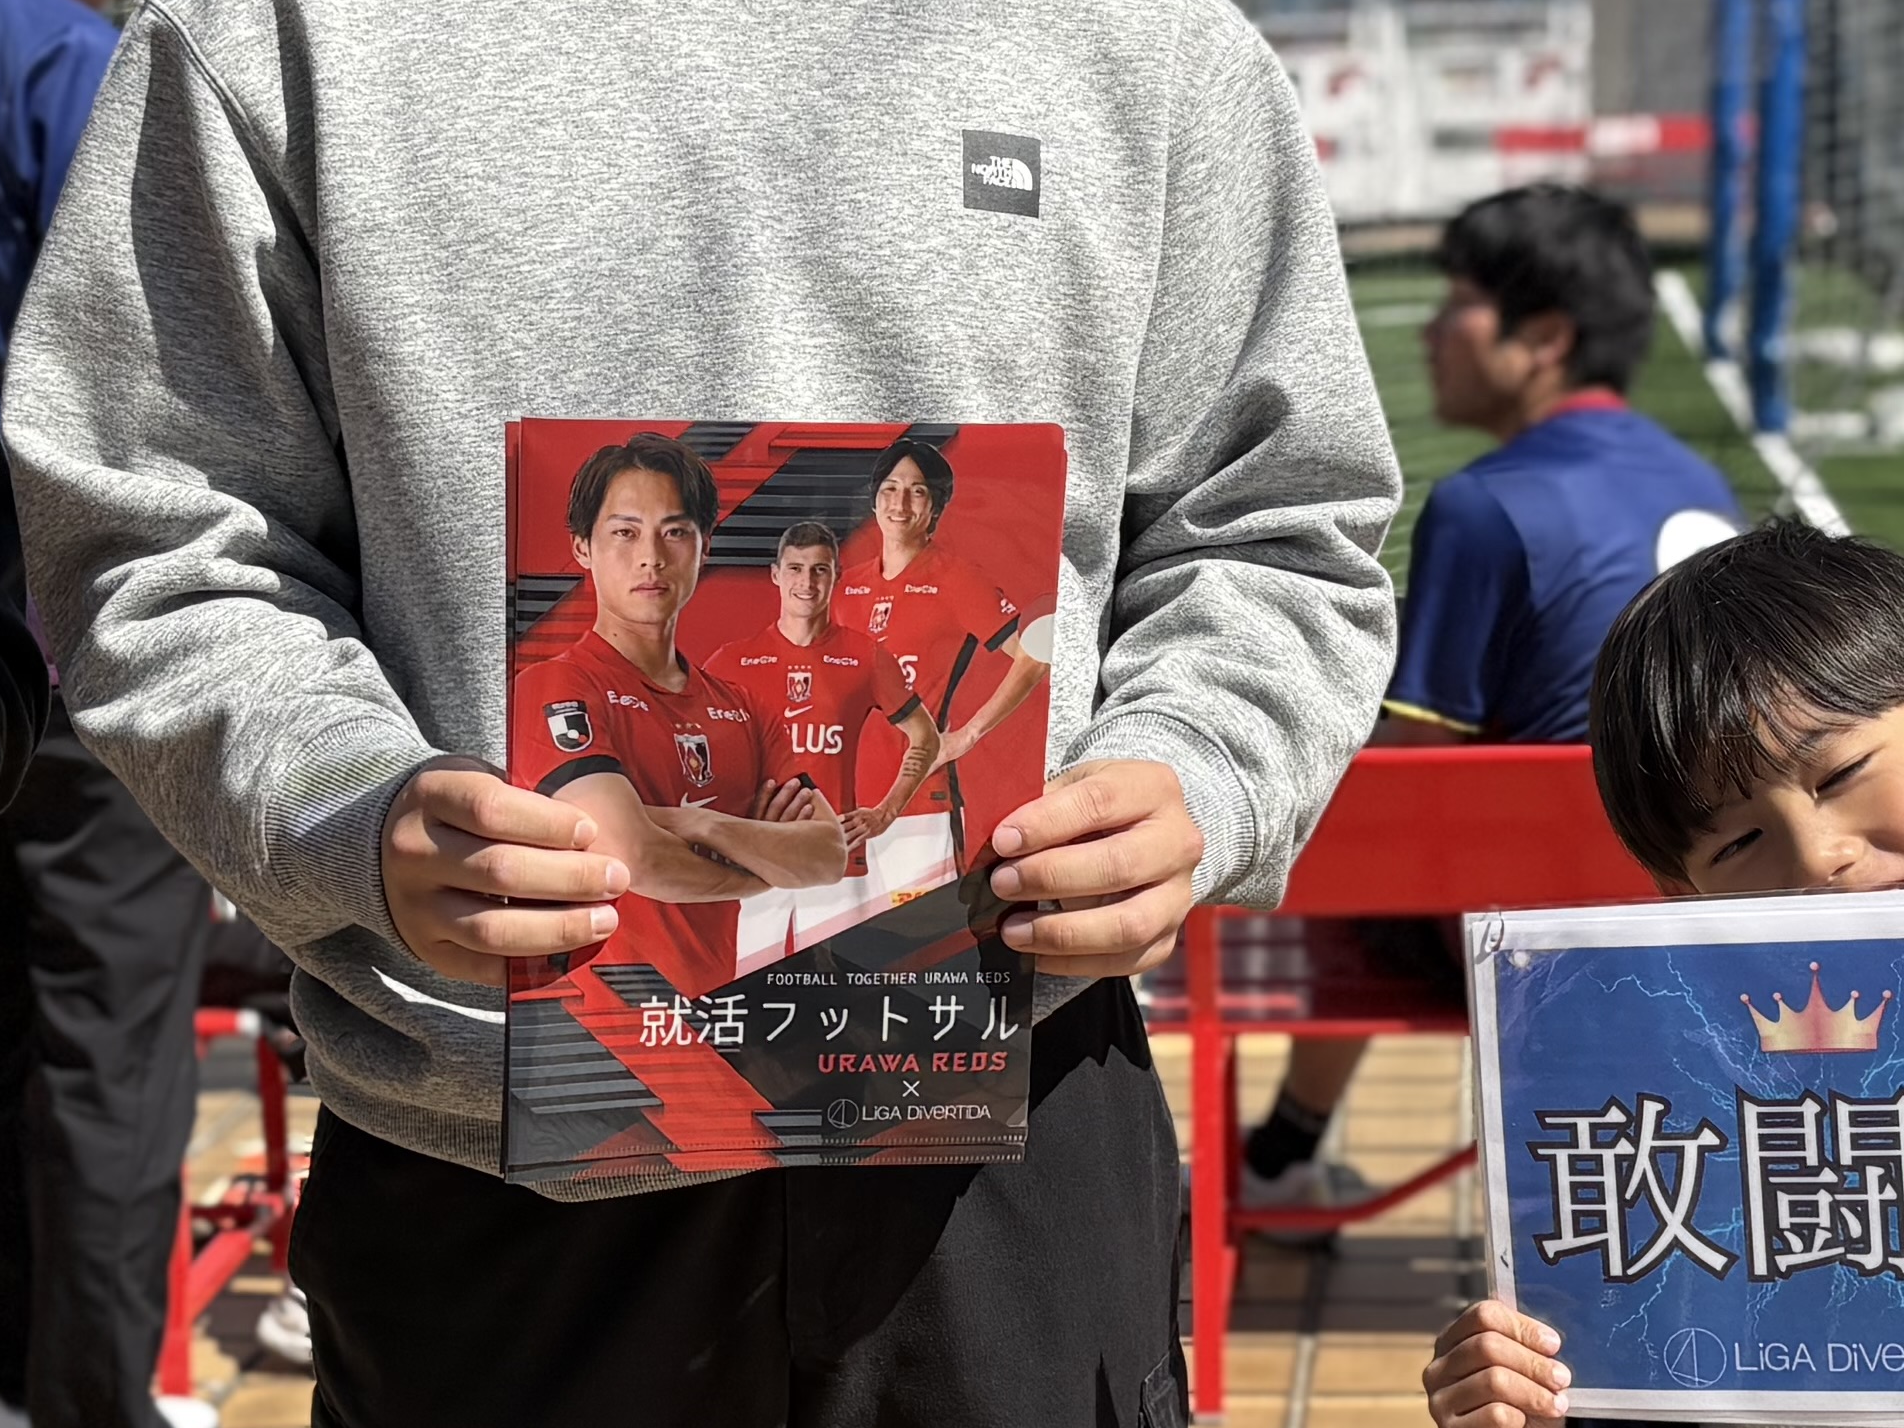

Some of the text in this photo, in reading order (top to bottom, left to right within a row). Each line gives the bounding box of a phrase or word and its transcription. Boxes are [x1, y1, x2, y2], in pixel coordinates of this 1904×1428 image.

[783, 722, 844, 755] LUS
[767, 972, 1011, 986] FOOTBALL TOGETHER URAWA REDS
[639, 993, 1019, 1048] 就活フットサル
[818, 1051, 1008, 1073] URAWA REDS
